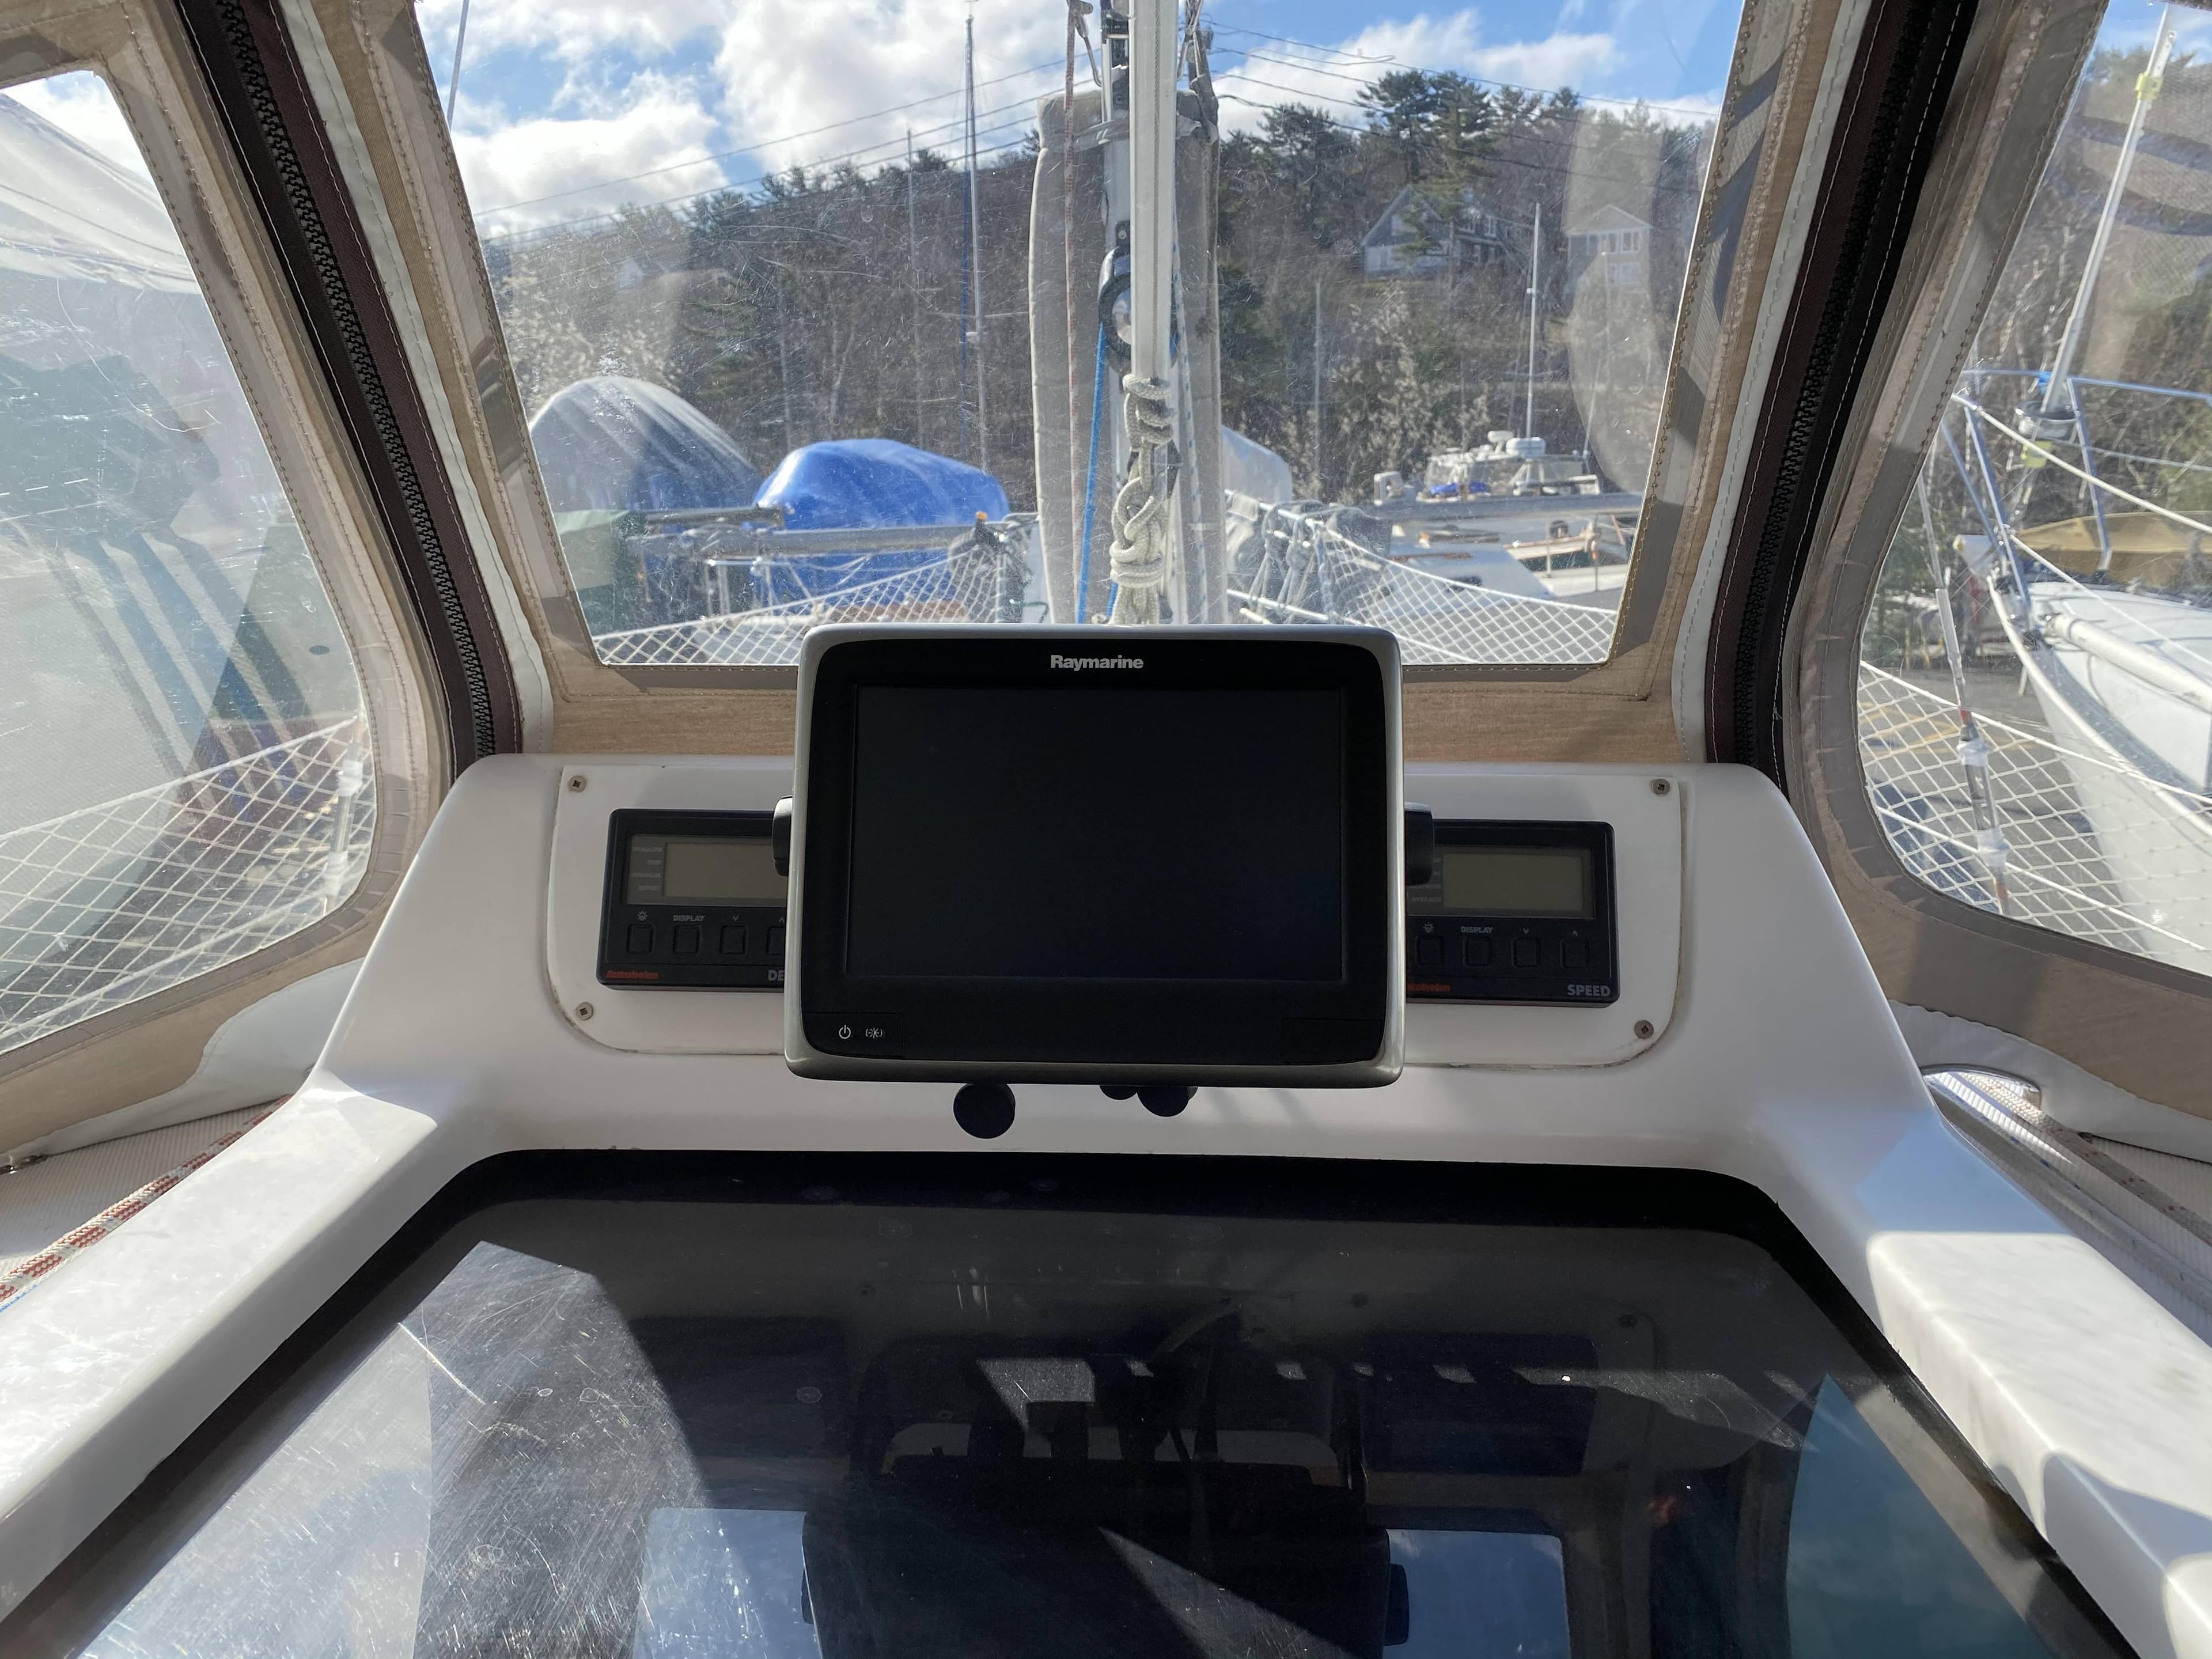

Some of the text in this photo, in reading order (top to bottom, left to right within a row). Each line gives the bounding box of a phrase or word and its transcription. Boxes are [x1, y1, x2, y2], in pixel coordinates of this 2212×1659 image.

[1050, 654, 1144, 672] Raymarine
[1460, 926, 1493, 934] DISPLAY
[1567, 984, 1611, 997] SPEED
